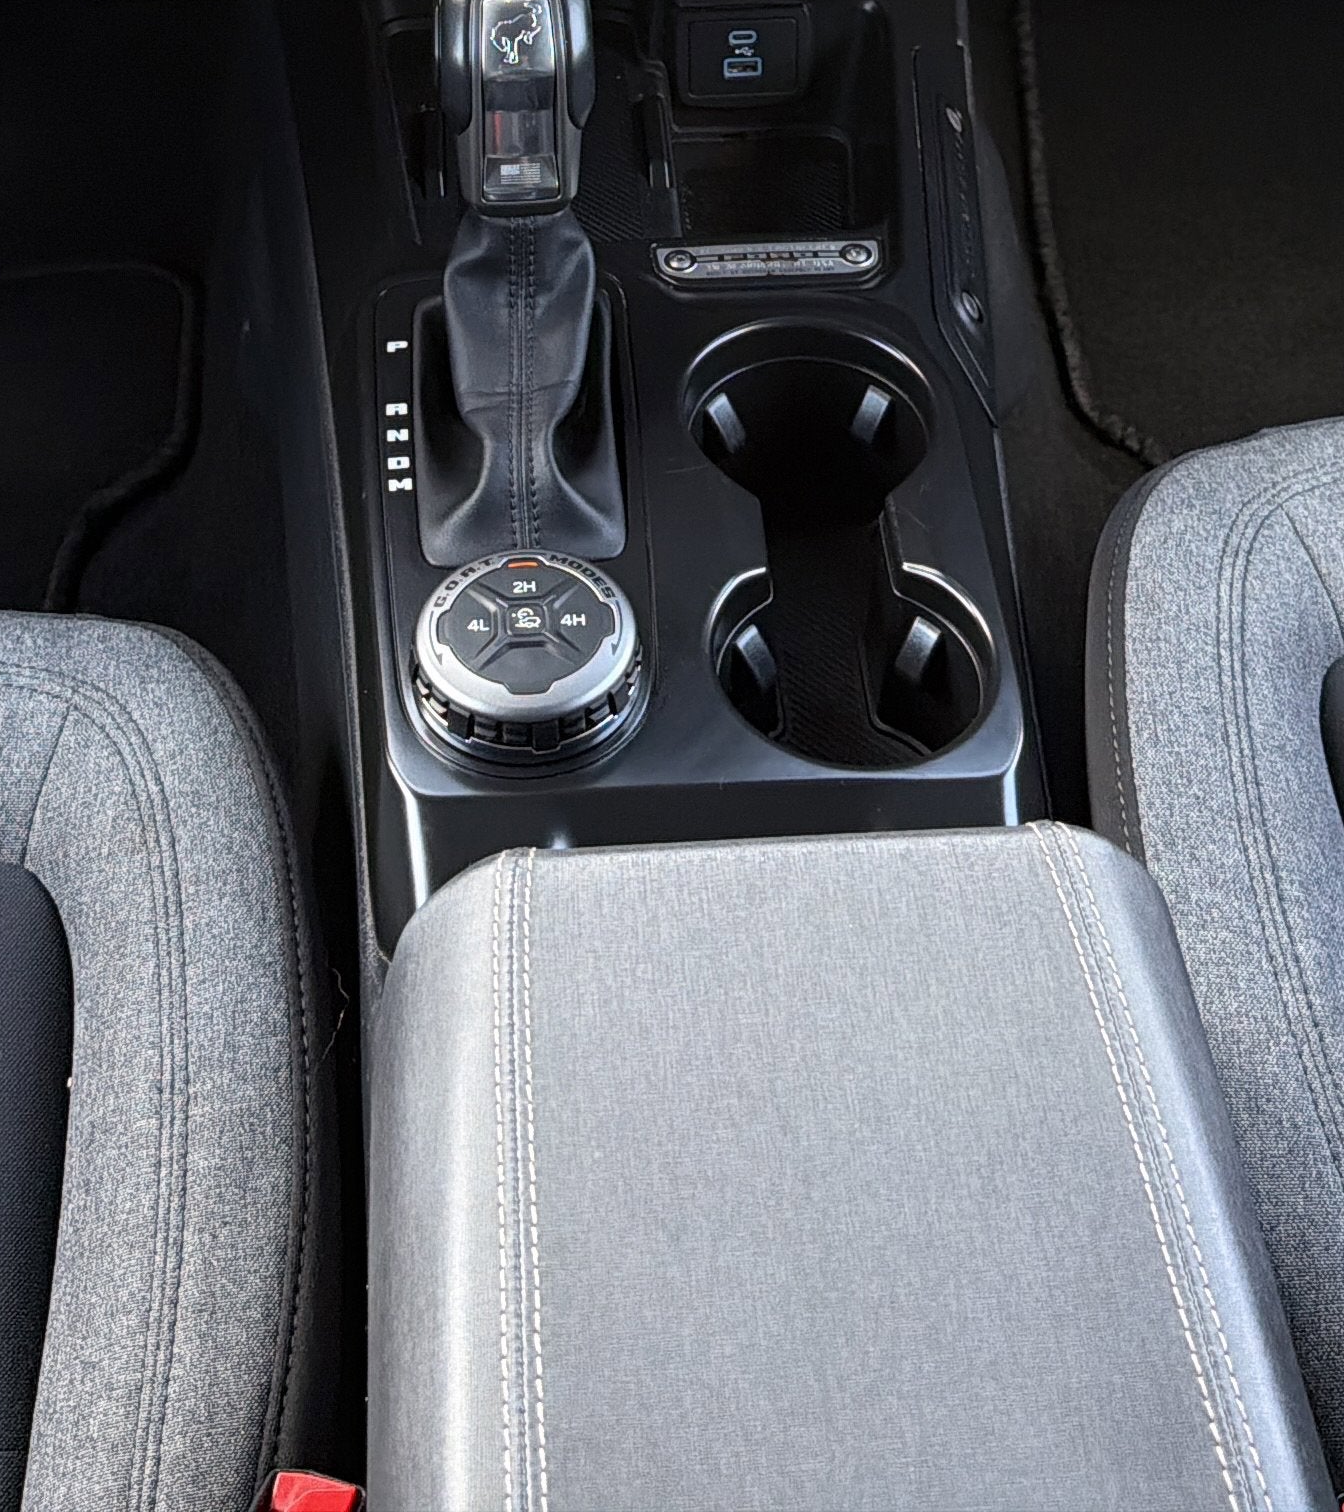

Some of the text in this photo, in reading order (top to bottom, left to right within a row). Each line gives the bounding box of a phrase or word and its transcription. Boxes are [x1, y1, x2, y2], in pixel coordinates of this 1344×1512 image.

[386, 341, 408, 353] P
[386, 429, 409, 442] N
[387, 456, 410, 470] D
[388, 478, 413, 492] M
[549, 554, 617, 599] MODES
[512, 581, 537, 594] 2H
[467, 619, 490, 632] 4L
[560, 613, 586, 627] 4H
